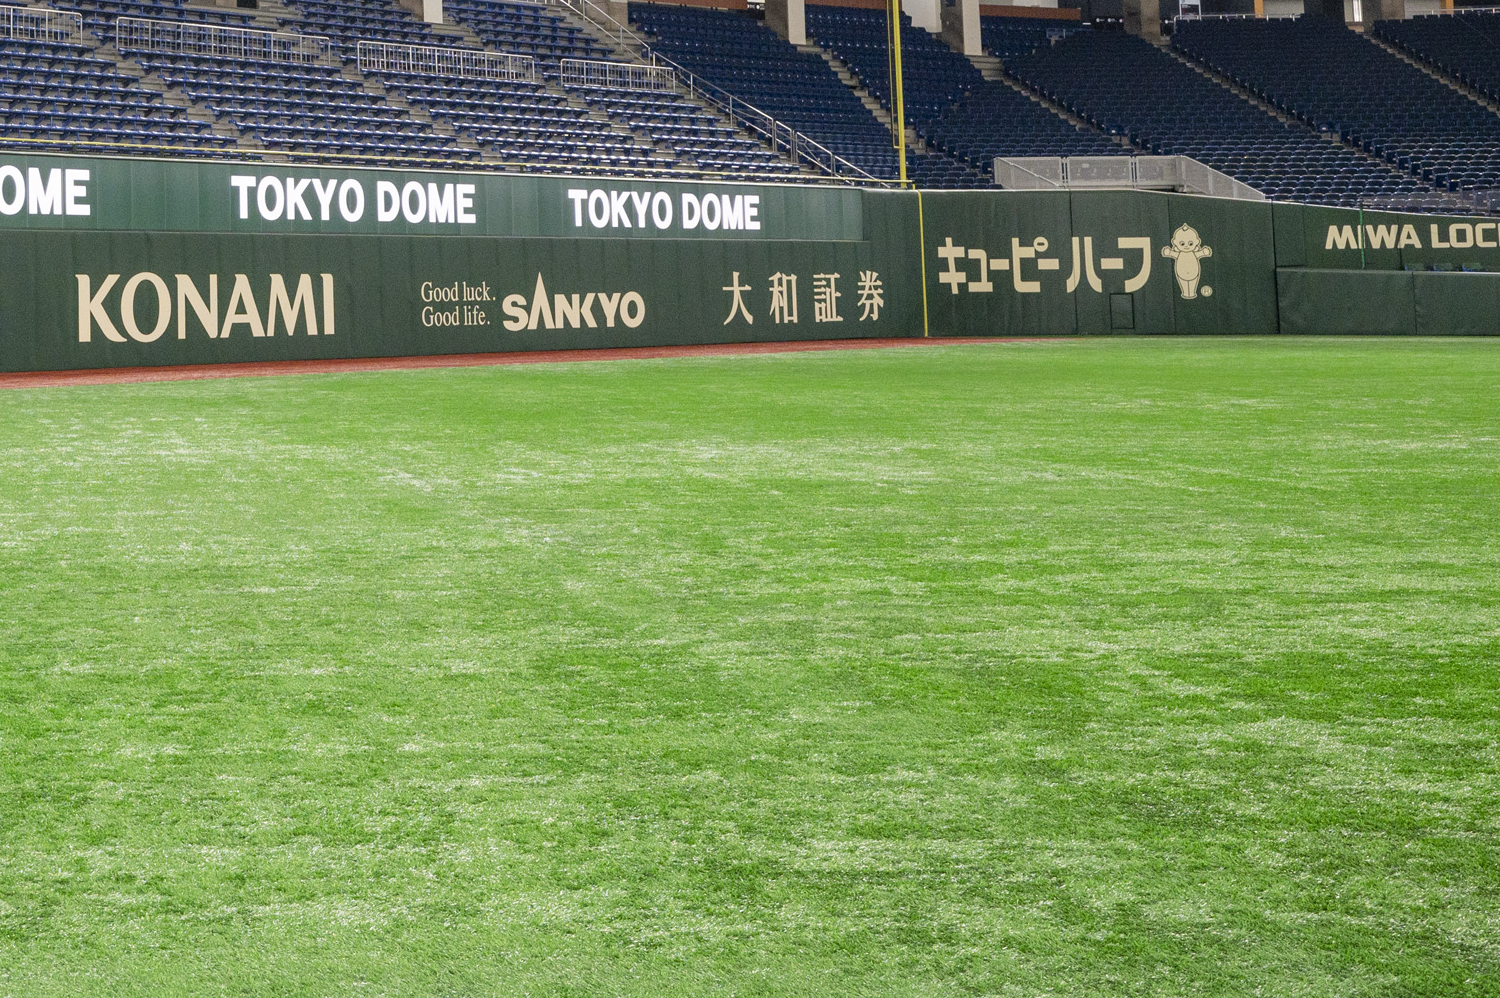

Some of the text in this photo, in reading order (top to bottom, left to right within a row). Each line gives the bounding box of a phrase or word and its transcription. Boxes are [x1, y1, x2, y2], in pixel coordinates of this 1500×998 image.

[231, 174, 477, 224] TOKYO DOME
[568, 188, 761, 231] TOKYO DOME
[1325, 222, 1500, 250] MIWA LOC
[937, 236, 1152, 295] キューピーハーフ
[75, 271, 335, 343] KONAMI
[421, 281, 496, 303] Good luck.
[421, 304, 491, 327] Good life.
[502, 271, 646, 332] SANKYO
[722, 270, 884, 326] 大和証券
